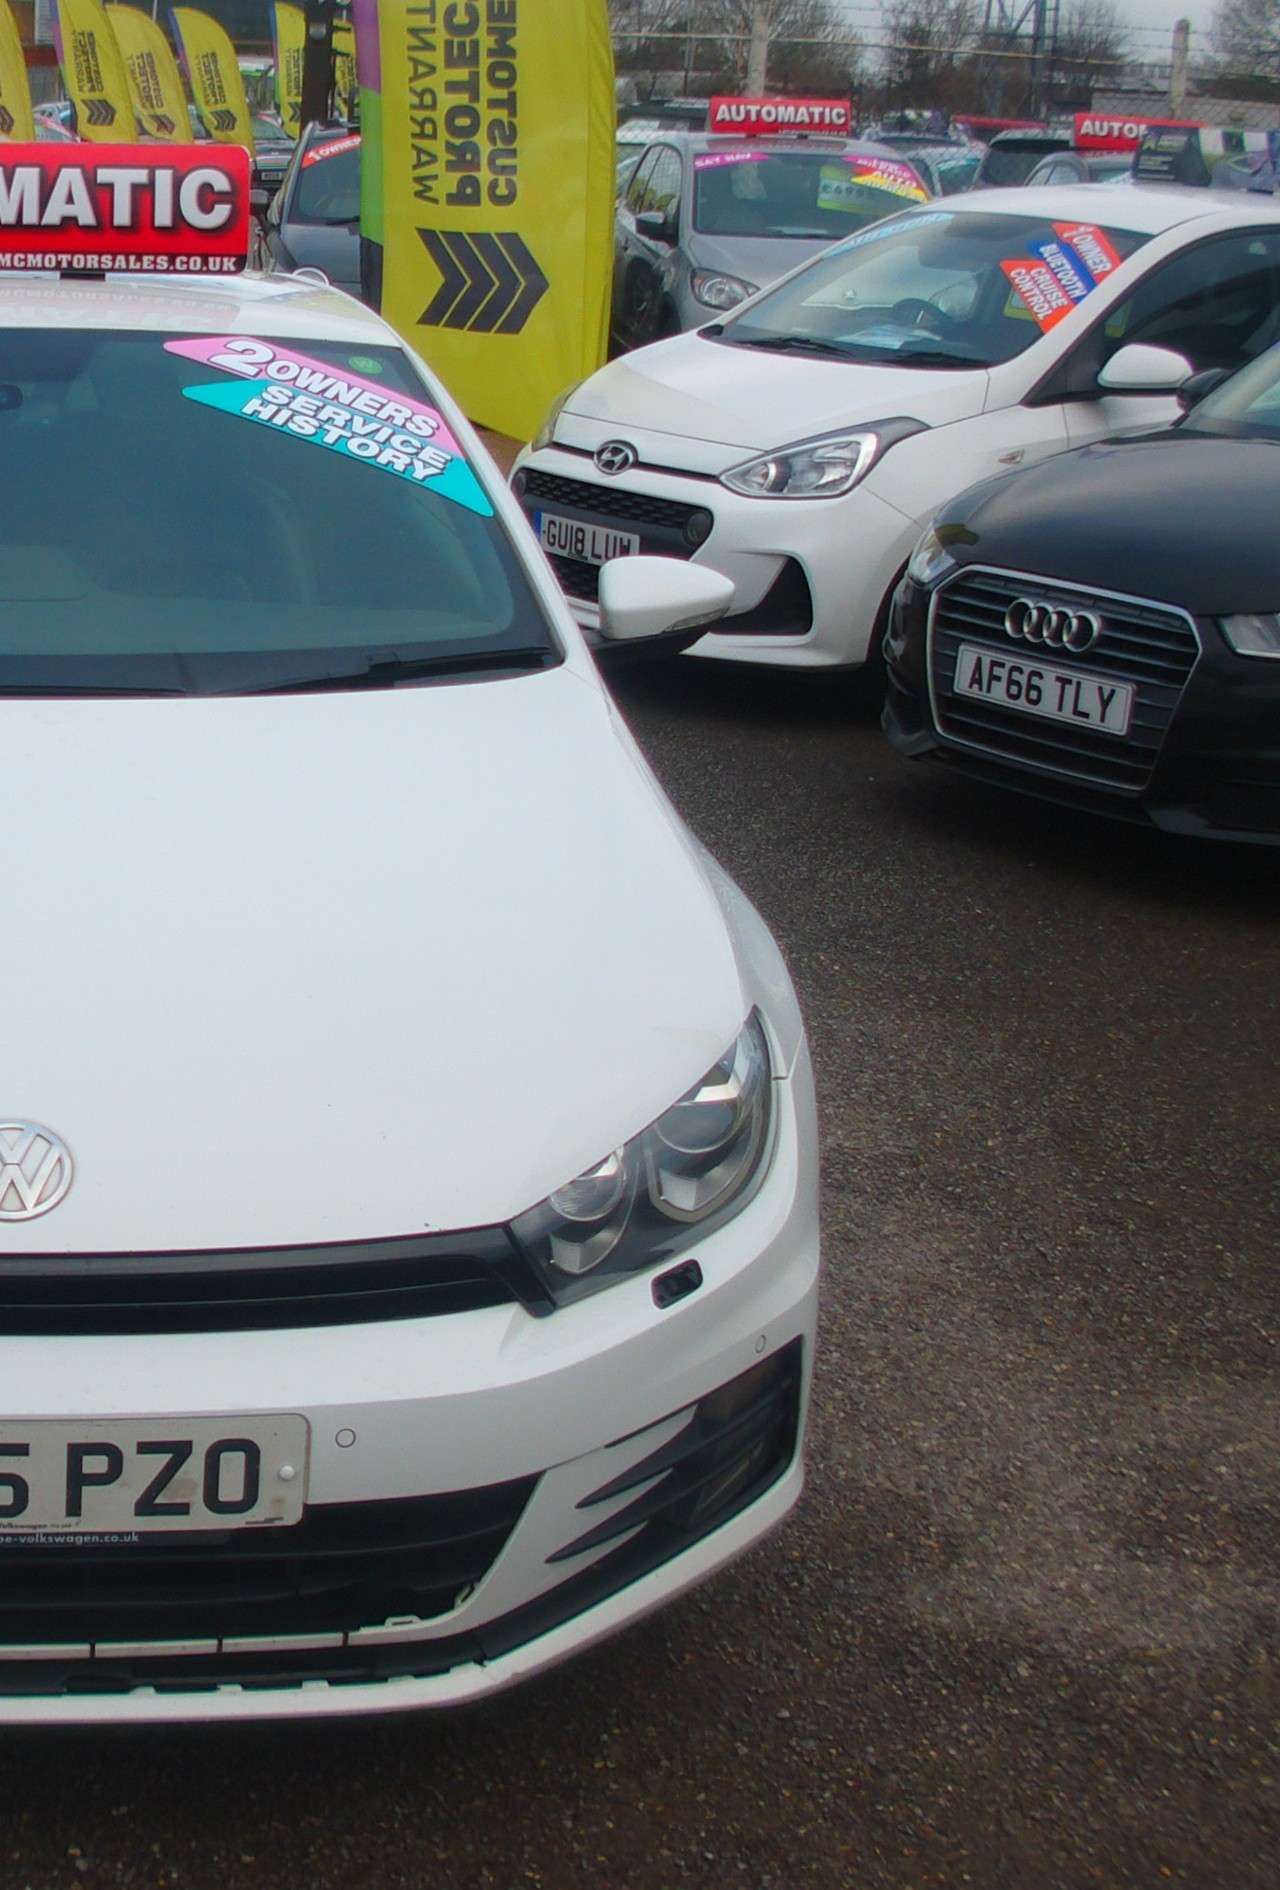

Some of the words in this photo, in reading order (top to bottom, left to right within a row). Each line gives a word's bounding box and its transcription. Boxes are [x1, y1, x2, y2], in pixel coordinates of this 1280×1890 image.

[715, 103, 848, 125] AUTOMATIC
[1038, 243, 1087, 299] BLUETOOTH
[1072, 234, 1113, 276] OWNER
[1009, 268, 1054, 321] CONTROL
[1029, 267, 1068, 310] CRUISE
[210, 339, 275, 377] 2
[266, 358, 439, 439] OWNERS
[241, 397, 447, 482] HISTORY
[261, 384, 453, 470] SERVICE
[546, 519, 586, 556] GU18
[967, 655, 1044, 707] AF66
[1054, 675, 1117, 724] TLY
[65, 1438, 261, 1516] PZO
